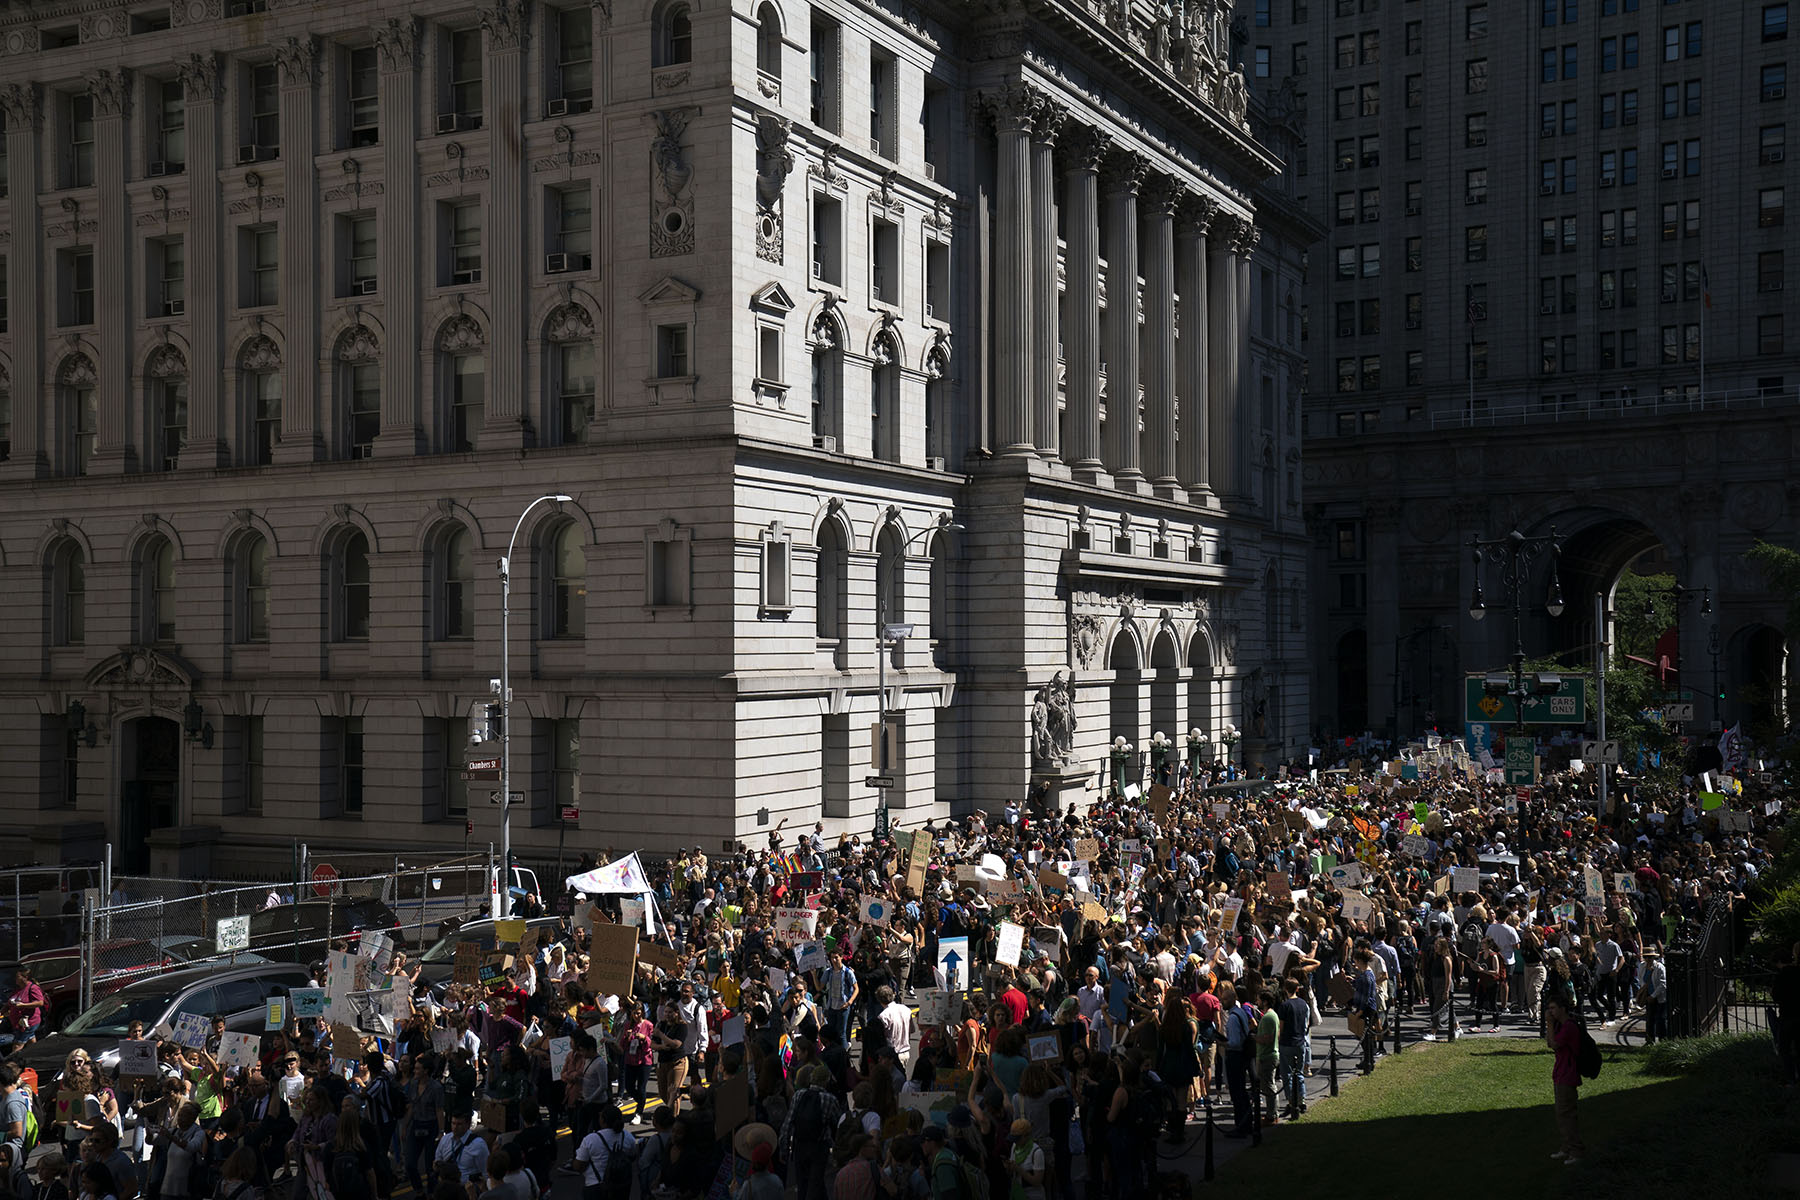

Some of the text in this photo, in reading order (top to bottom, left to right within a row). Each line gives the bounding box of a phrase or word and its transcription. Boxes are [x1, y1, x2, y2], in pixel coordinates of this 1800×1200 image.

[1551, 698, 1575, 706] CARS
[469, 761, 496, 770] Chambers St
[470, 772, 475, 780] St
[876, 809, 884, 834] PARK
[313, 874, 336, 886] STOP
[557, 904, 570, 912] NOW
[780, 929, 810, 940] FICTION
